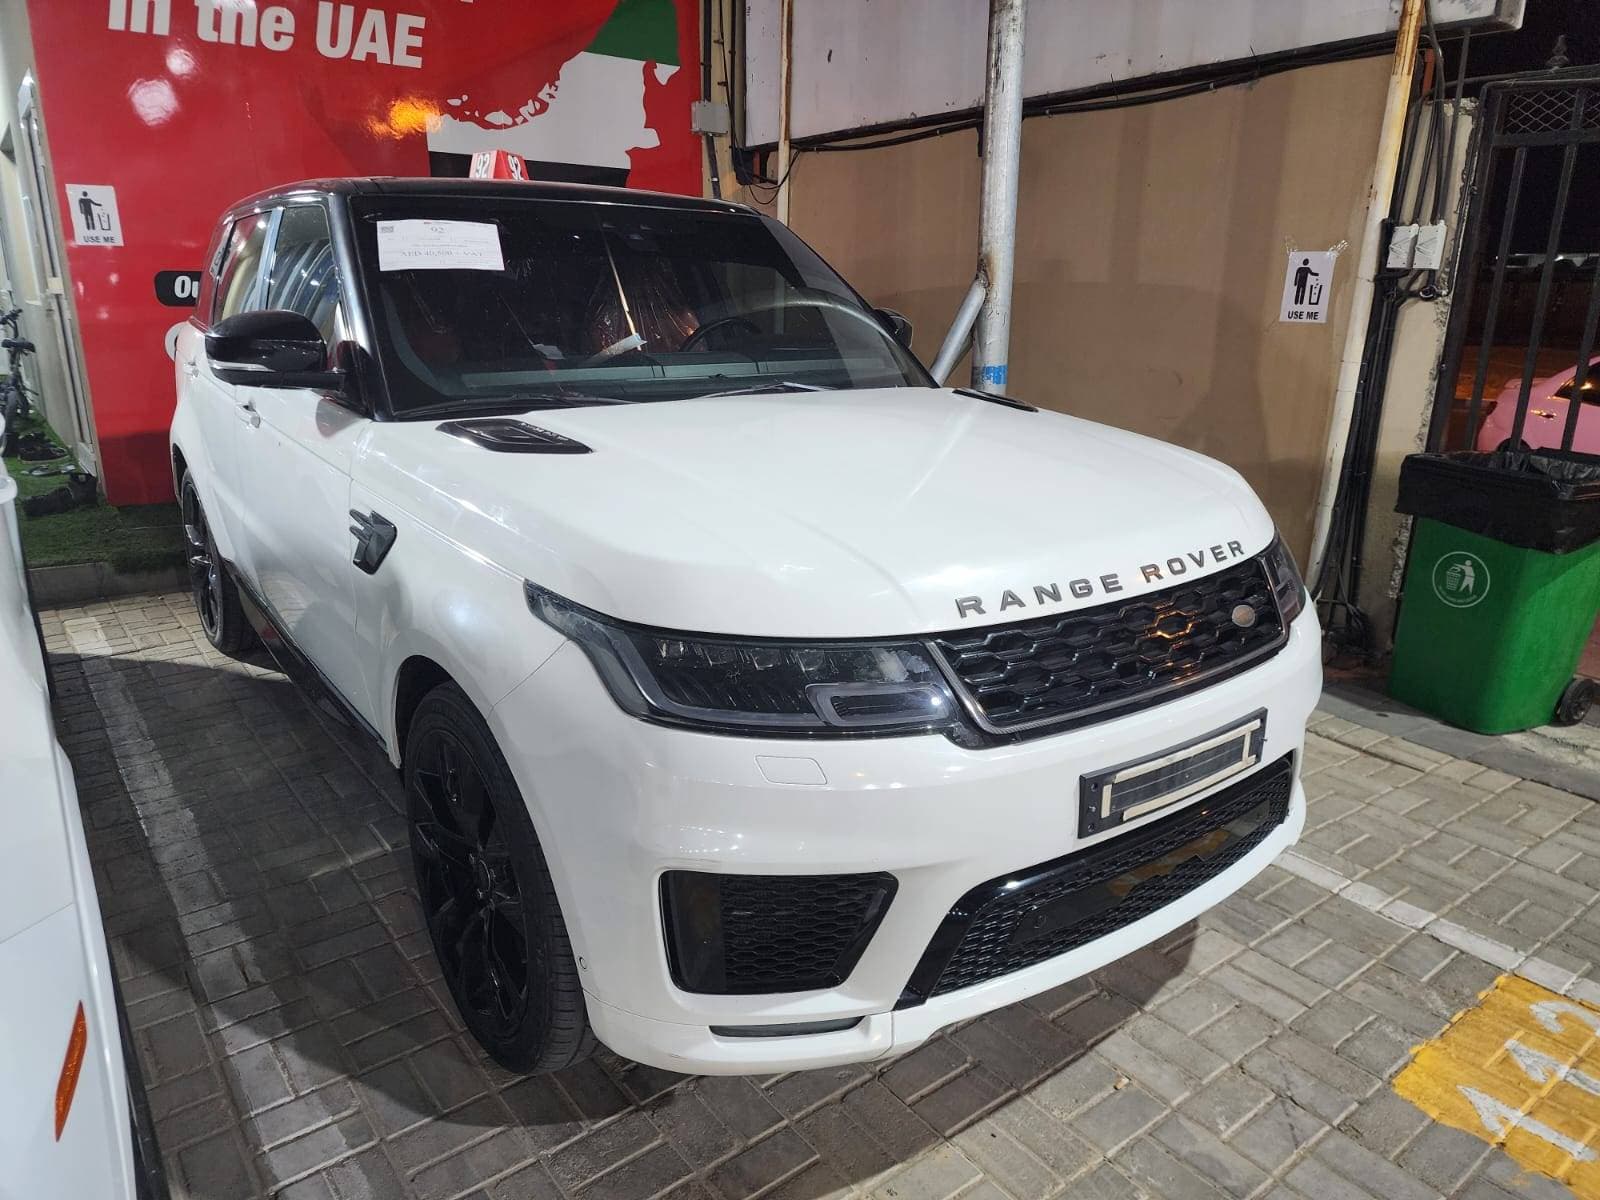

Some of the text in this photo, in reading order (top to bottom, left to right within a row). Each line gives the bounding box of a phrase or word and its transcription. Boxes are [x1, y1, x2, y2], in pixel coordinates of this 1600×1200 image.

[195, 0, 295, 51] the
[315, 1, 426, 68] UAE
[475, 152, 490, 178] 92
[83, 235, 100, 243] USE
[1288, 311, 1319, 320] USE ME
[955, 540, 1245, 618] RANGE ROVER
